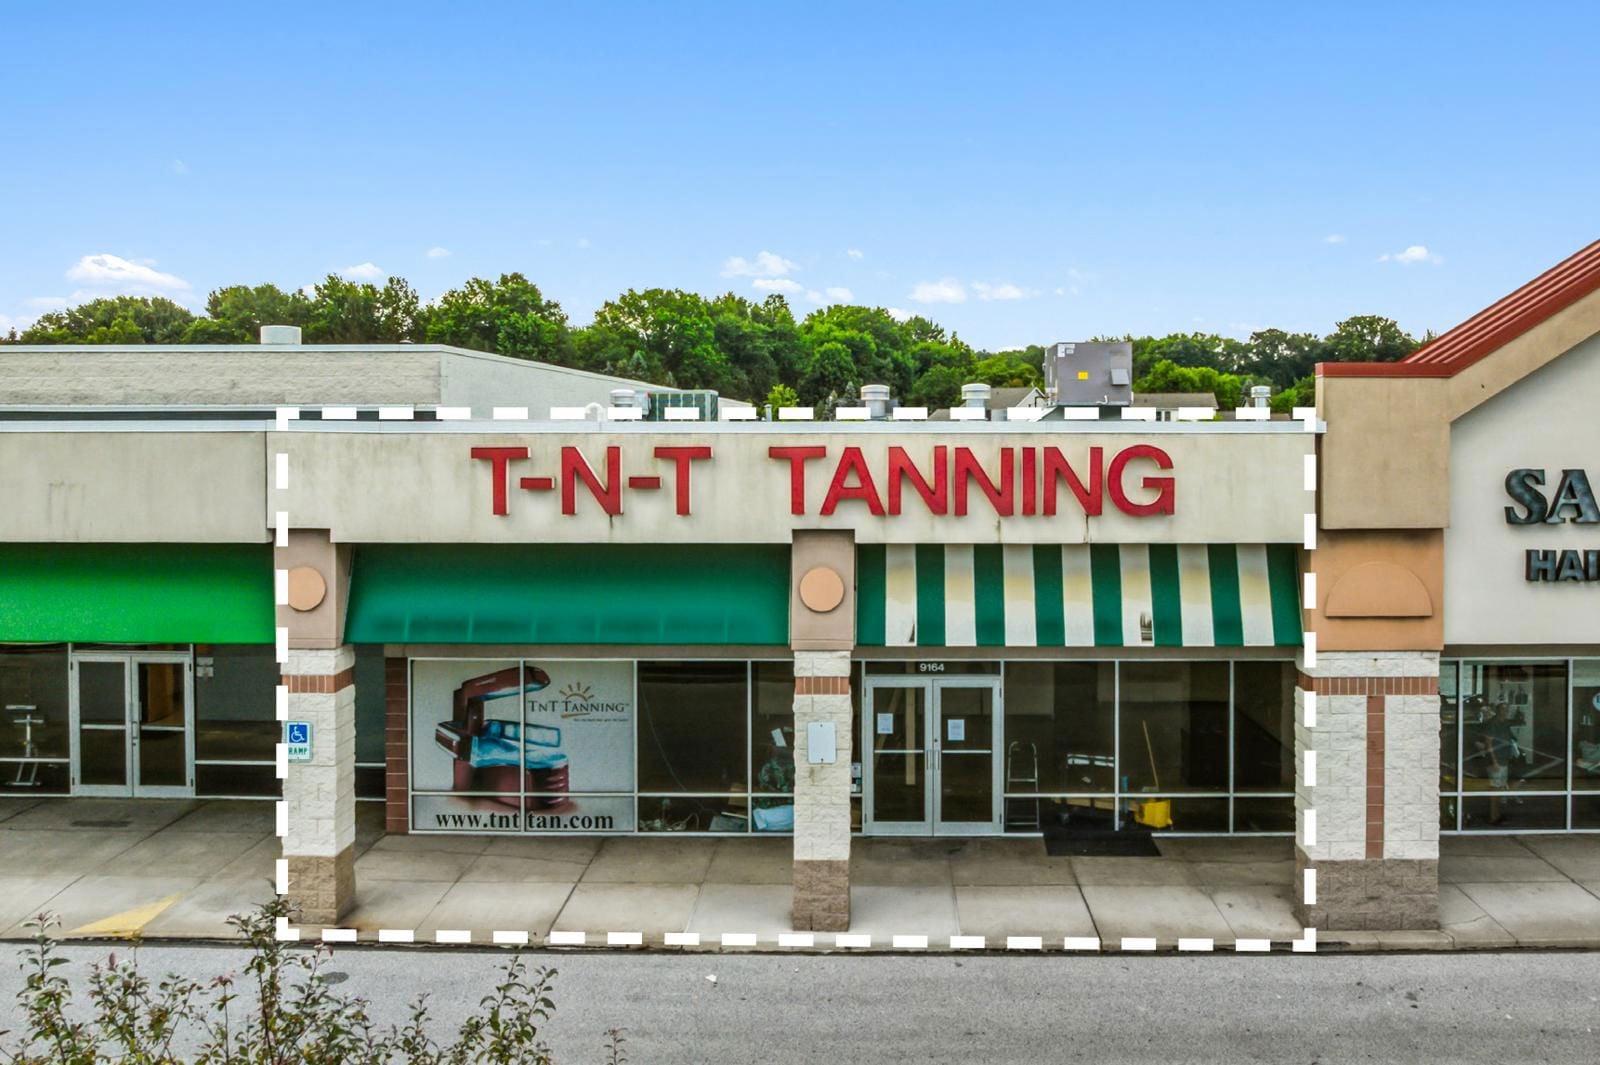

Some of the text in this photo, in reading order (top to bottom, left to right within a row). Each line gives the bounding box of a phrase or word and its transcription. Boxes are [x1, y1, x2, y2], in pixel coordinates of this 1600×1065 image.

[471, 445, 1176, 517] T-N-T TANNING
[1525, 549, 1600, 581] HAI
[920, 663, 944, 672] 9164
